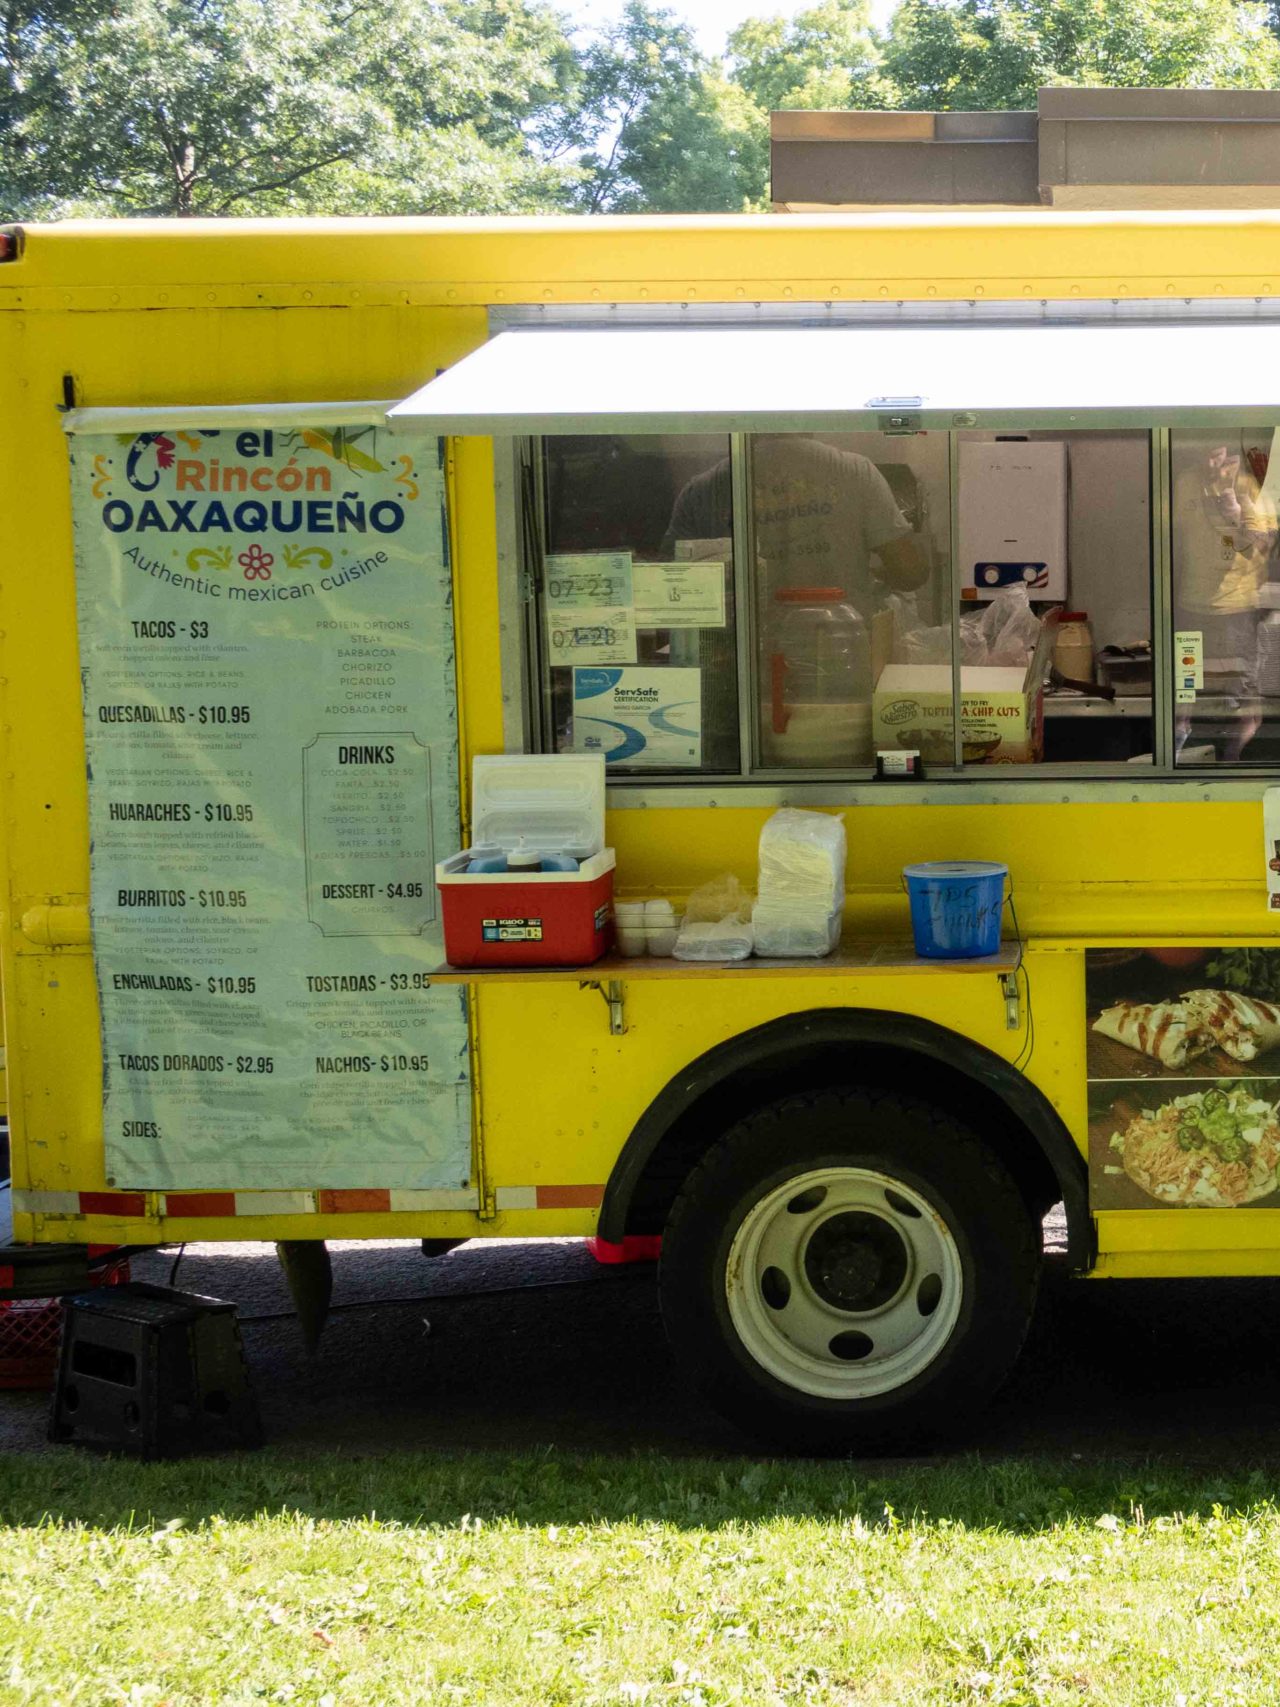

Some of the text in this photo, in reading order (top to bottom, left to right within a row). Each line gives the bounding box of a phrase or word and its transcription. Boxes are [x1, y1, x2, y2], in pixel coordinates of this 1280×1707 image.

[236, 431, 273, 458] el
[176, 457, 332, 492] Rincón
[102, 491, 406, 534] OAXAQUEÑO
[122, 545, 389, 602] Authentic mexican cuisine
[130, 620, 176, 639] TACOS
[190, 620, 208, 640] $3
[337, 649, 396, 657] BARBACOA
[342, 663, 392, 671] CHORIZO
[340, 677, 396, 686] PICADILLO
[345, 692, 392, 700] CHICKEN
[98, 705, 186, 724] QUESADILLAS
[198, 705, 250, 724] $10.95
[324, 705, 408, 714] ADOBADA PORK
[893, 702, 916, 712] Sabor
[997, 706, 1020, 717] CUTS
[338, 746, 394, 764] DRINKS
[110, 803, 191, 822] HUARACHES
[204, 803, 253, 822] $10.95
[117, 890, 186, 907] BURRITOS
[198, 890, 247, 908] $10.95
[322, 884, 376, 899] DESSERT
[386, 882, 422, 898] $4.95
[112, 974, 193, 992] ENCHILADAS
[208, 976, 256, 994] $10.95
[306, 975, 376, 992] TOSTADAS
[390, 973, 430, 991] $3.95
[118, 1054, 159, 1072] TACOS
[163, 1055, 224, 1072] DORADOS
[236, 1056, 274, 1073] $2.95
[380, 1054, 428, 1072] $10.95
[122, 1120, 162, 1139] SIDES:
